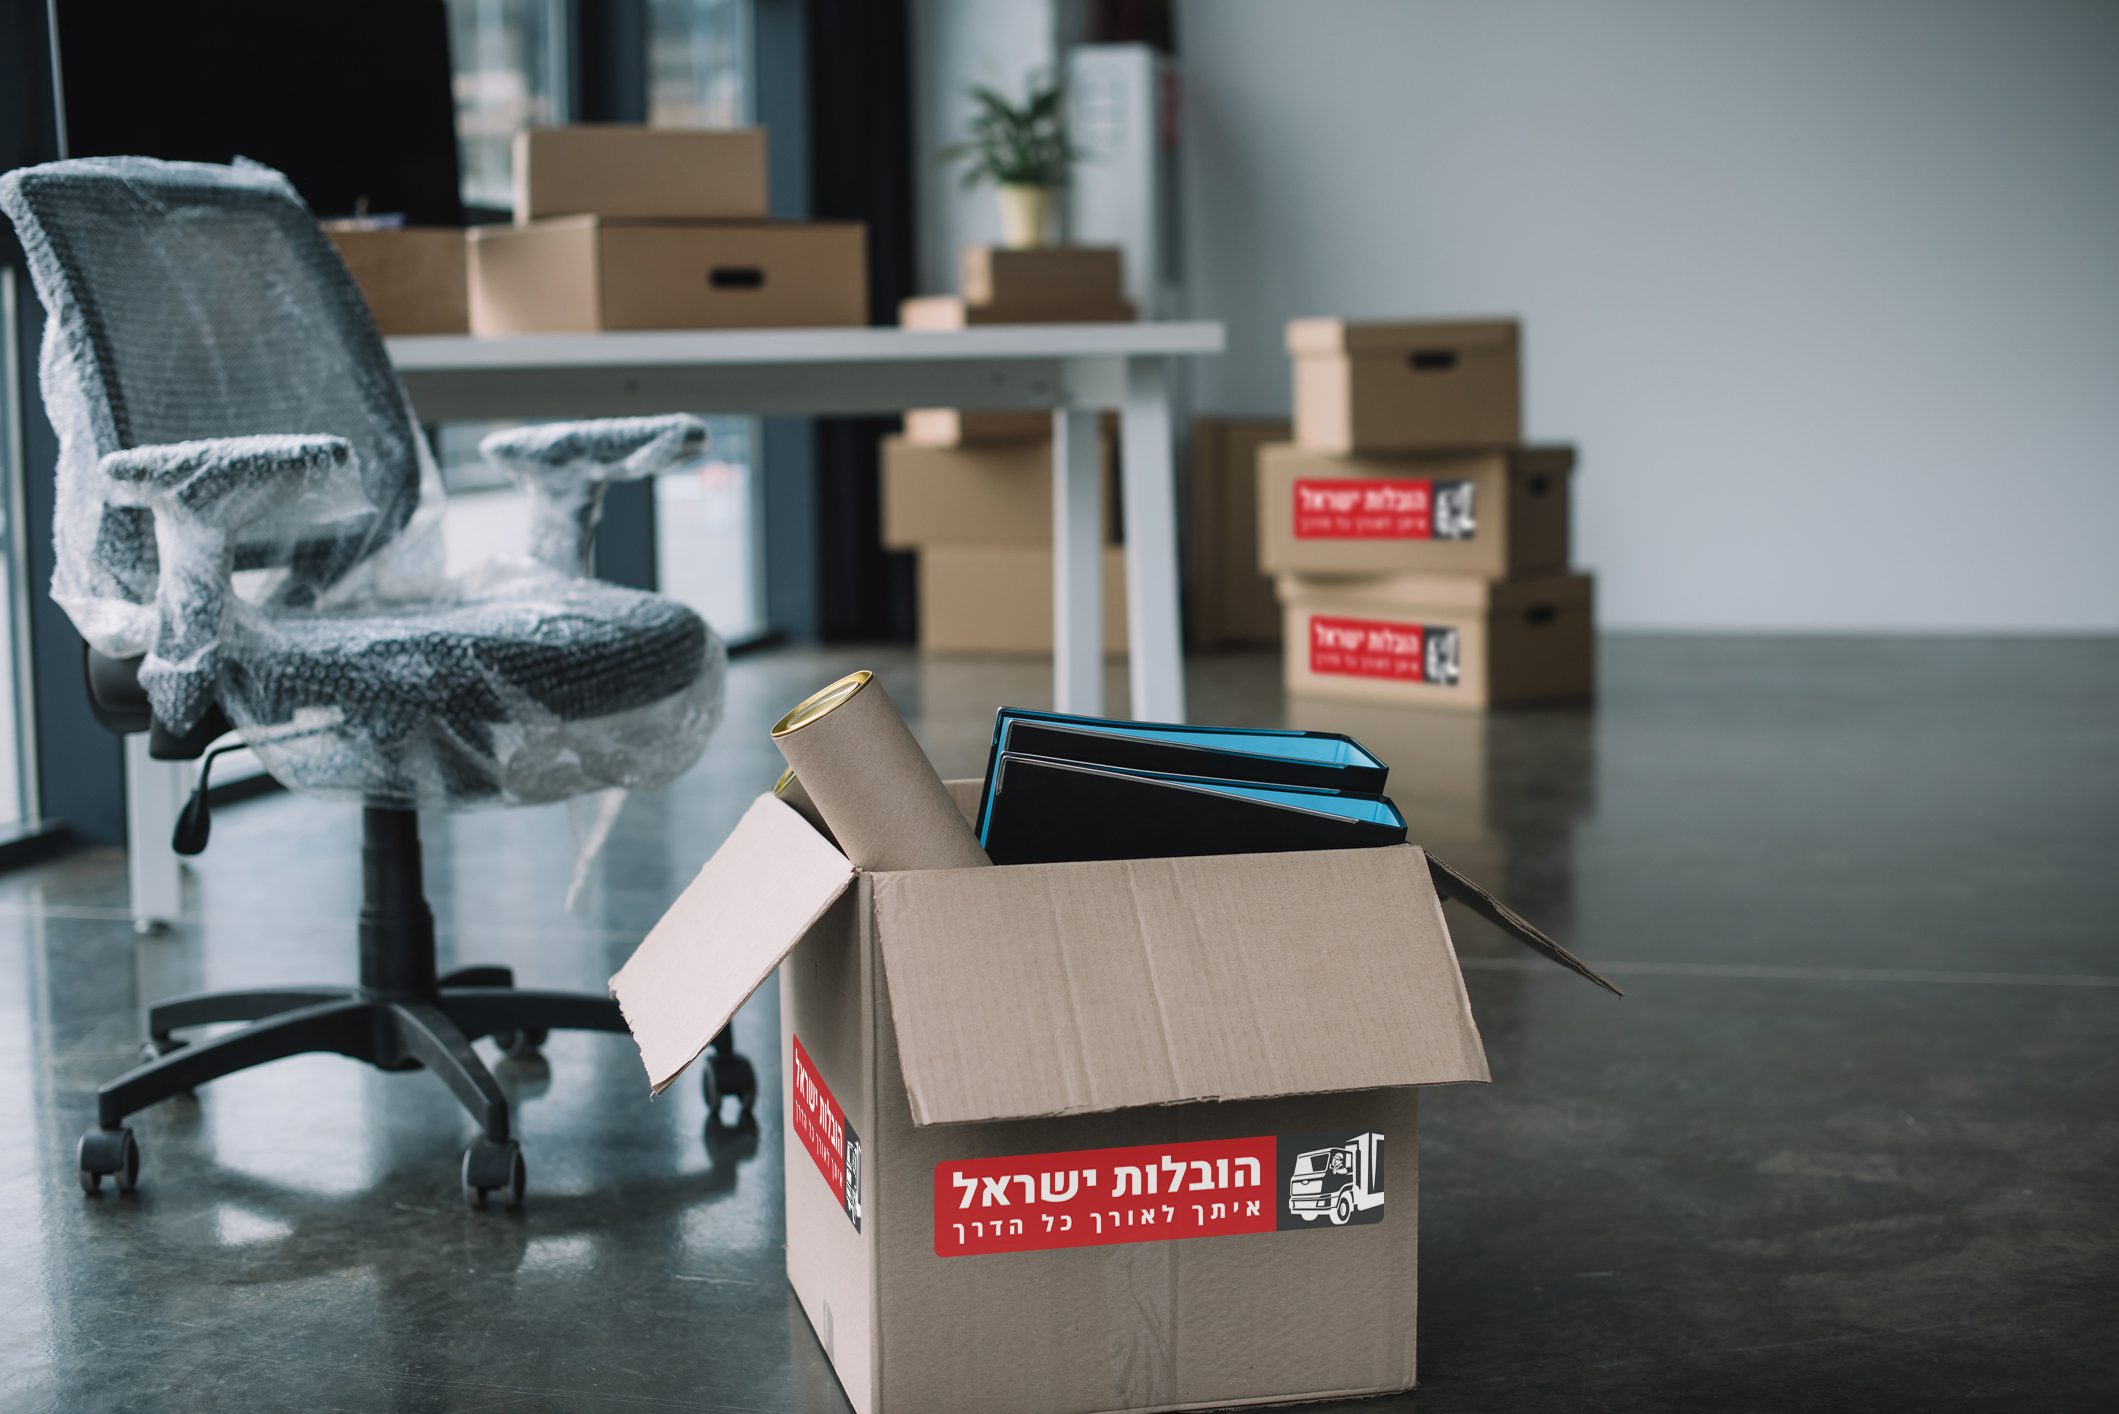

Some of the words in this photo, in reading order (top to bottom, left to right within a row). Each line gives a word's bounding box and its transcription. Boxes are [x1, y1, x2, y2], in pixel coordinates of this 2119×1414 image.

[795, 1048, 819, 1113] ישראל
[808, 1117, 815, 1143] כל
[819, 1096, 843, 1159] הובלות
[952, 1168, 1097, 1209] ישראל
[1112, 1154, 1261, 1198] הובלות
[1042, 1213, 1073, 1233] כל
[1090, 1204, 1175, 1234] לאורך
[1192, 1199, 1261, 1226] איתך
[952, 1217, 1023, 1245] הדרך
